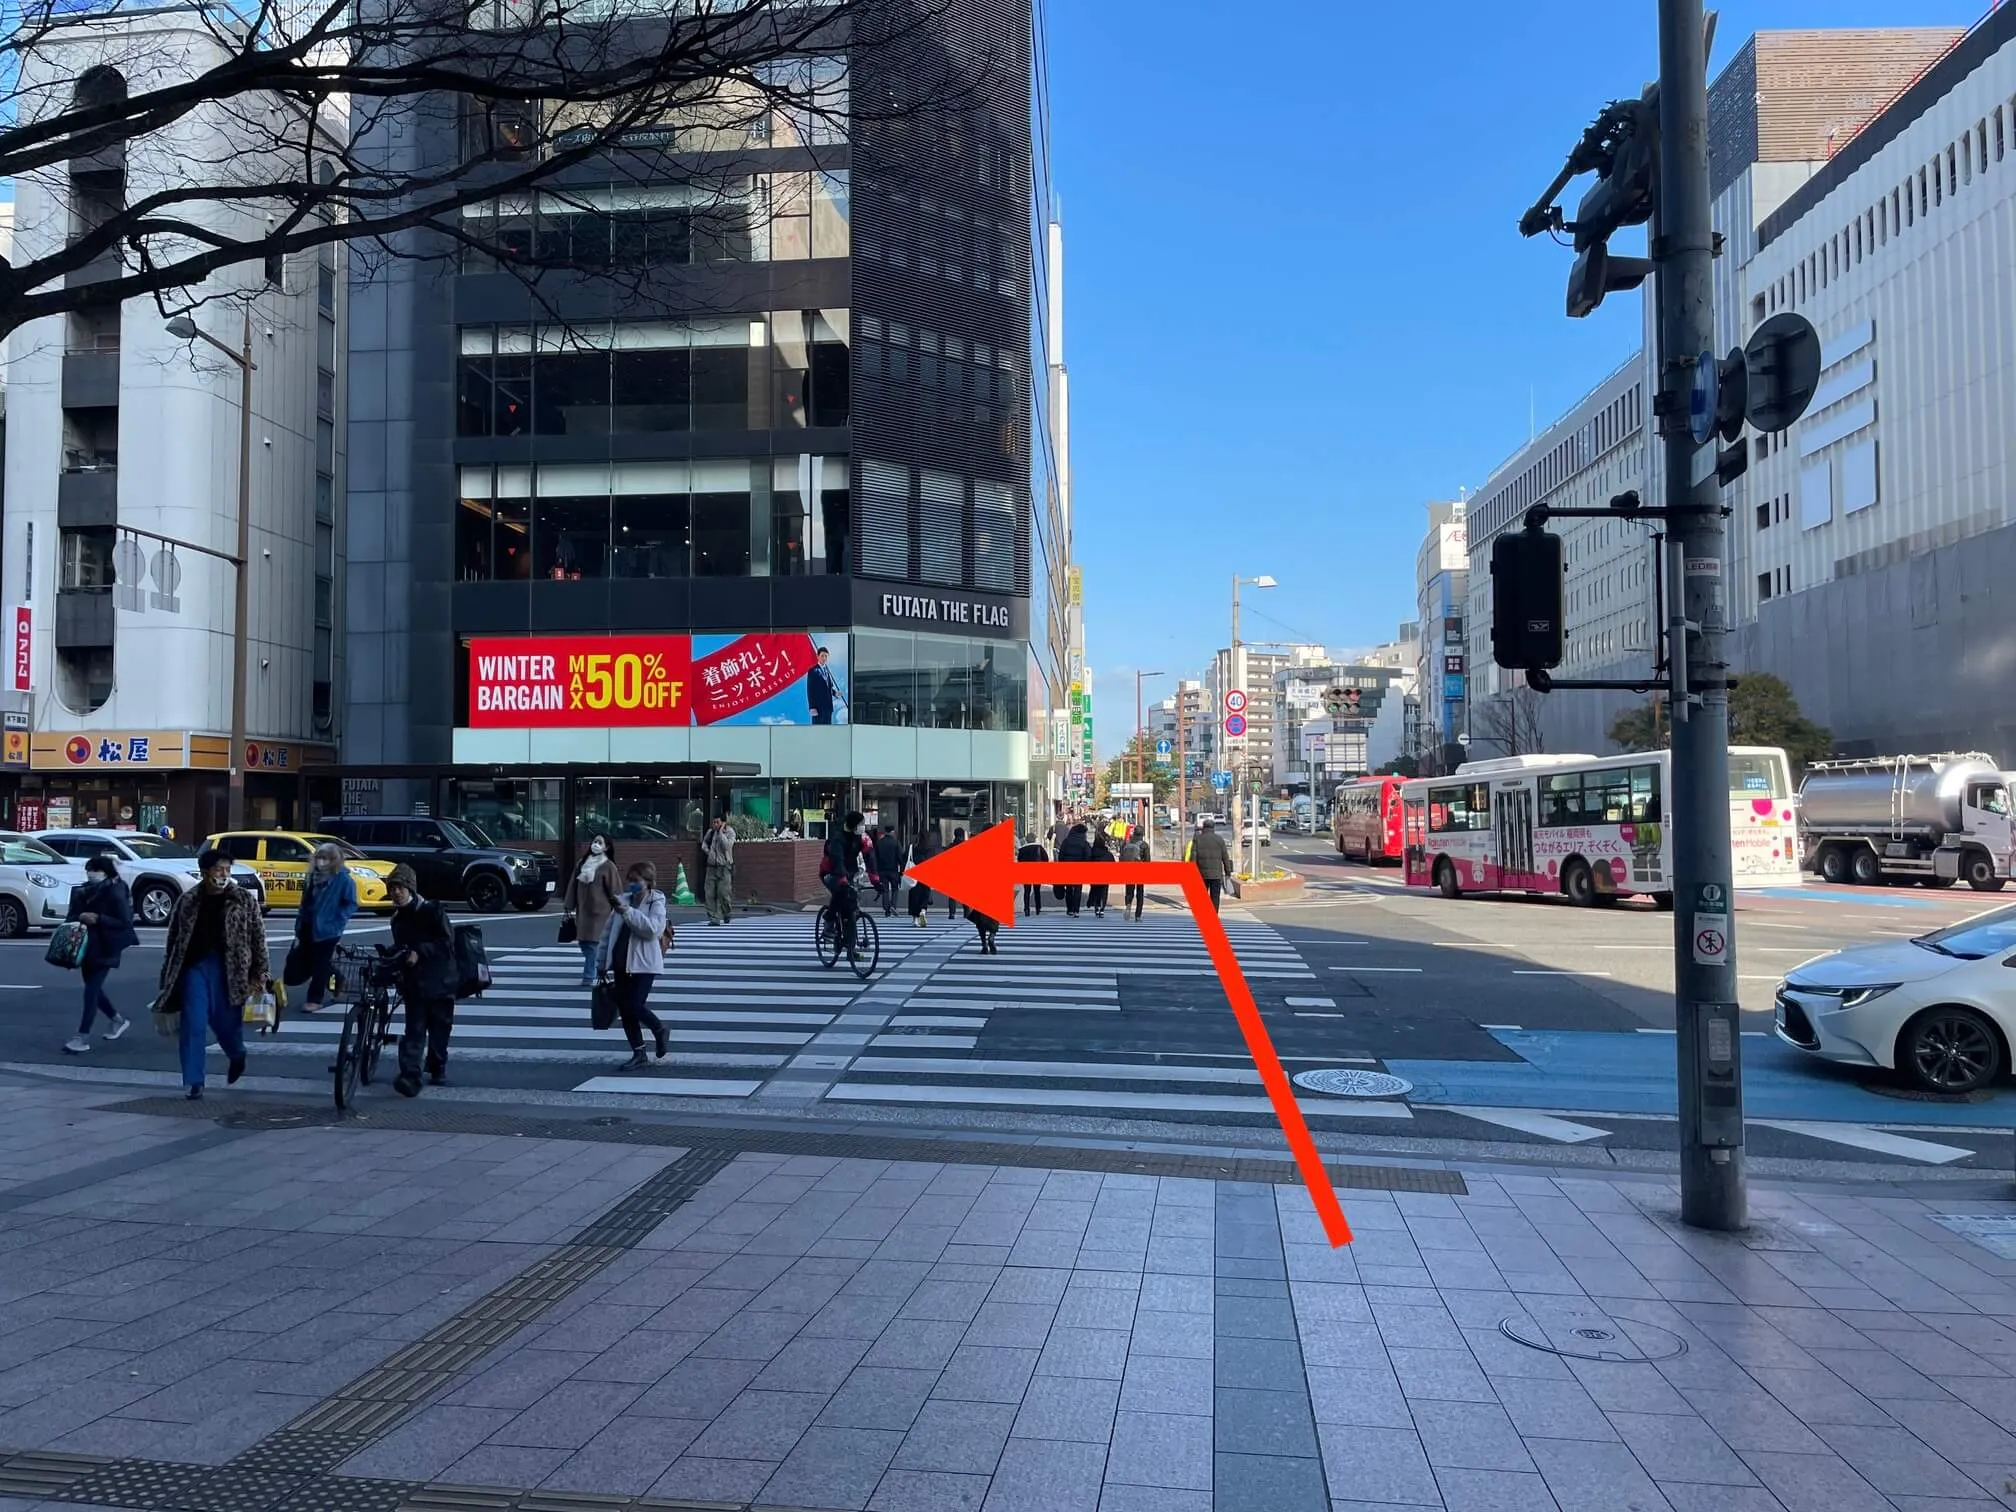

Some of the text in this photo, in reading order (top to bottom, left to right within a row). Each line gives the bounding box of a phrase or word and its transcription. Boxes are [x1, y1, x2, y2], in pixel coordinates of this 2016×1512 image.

[883, 594, 1009, 627] FUTATA THE FLAG
[17, 638, 29, 677] アコム
[478, 655, 555, 681] WINTER
[569, 654, 585, 709] MAX
[478, 684, 563, 711] BARGAIN
[643, 681, 683, 708] OFF
[712, 695, 750, 710] ENJOY!
[1230, 695, 1243, 706] 40
[98, 738, 149, 763] 松屋
[262, 749, 288, 767] 松屋
[342, 778, 379, 791] FUTATA
[342, 791, 361, 804] THE
